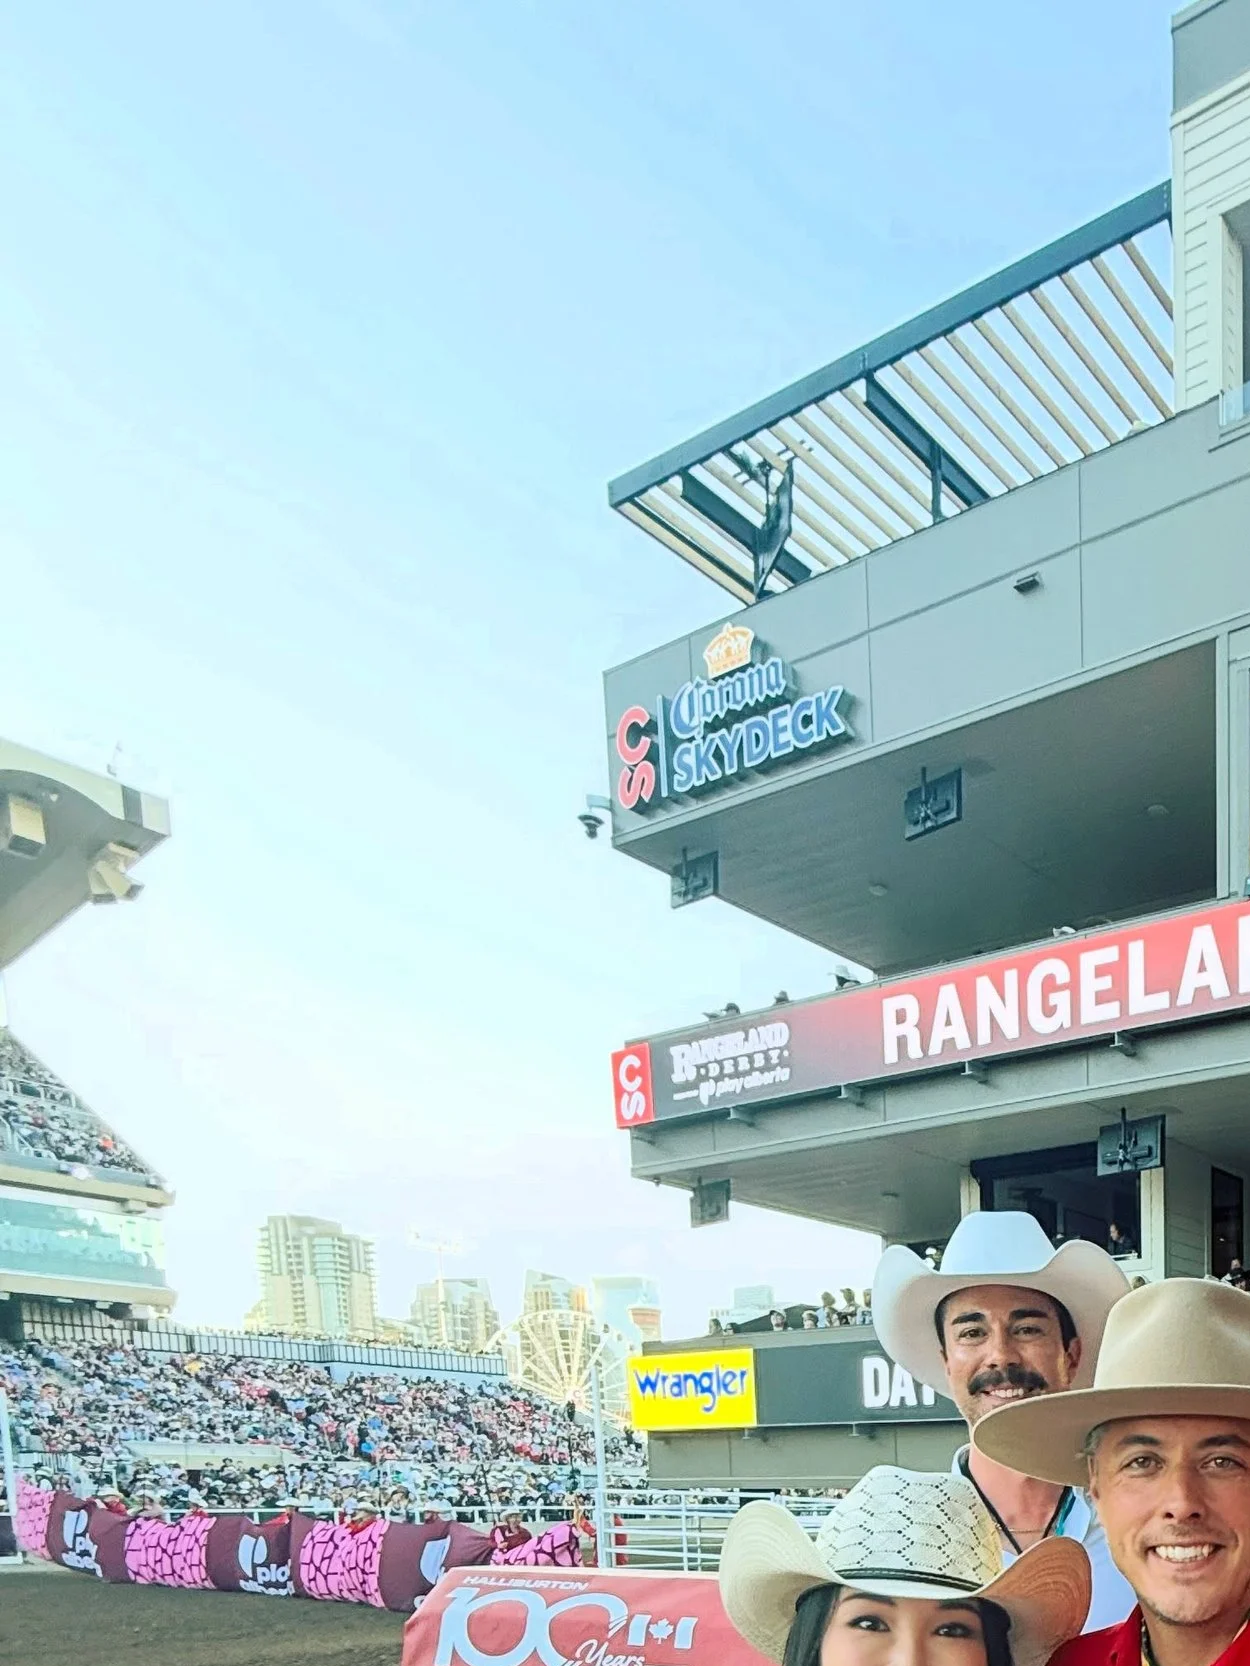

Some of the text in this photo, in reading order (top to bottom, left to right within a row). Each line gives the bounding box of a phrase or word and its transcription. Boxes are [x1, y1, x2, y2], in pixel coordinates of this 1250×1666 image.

[670, 657, 787, 739] Corona
[673, 685, 845, 792] SKYDECK
[669, 1022, 790, 1084] RANGELAND
[708, 1049, 780, 1077] DERBY
[633, 1364, 748, 1412] Wrangler
[463, 1576, 589, 1591] HALLIBURTON
